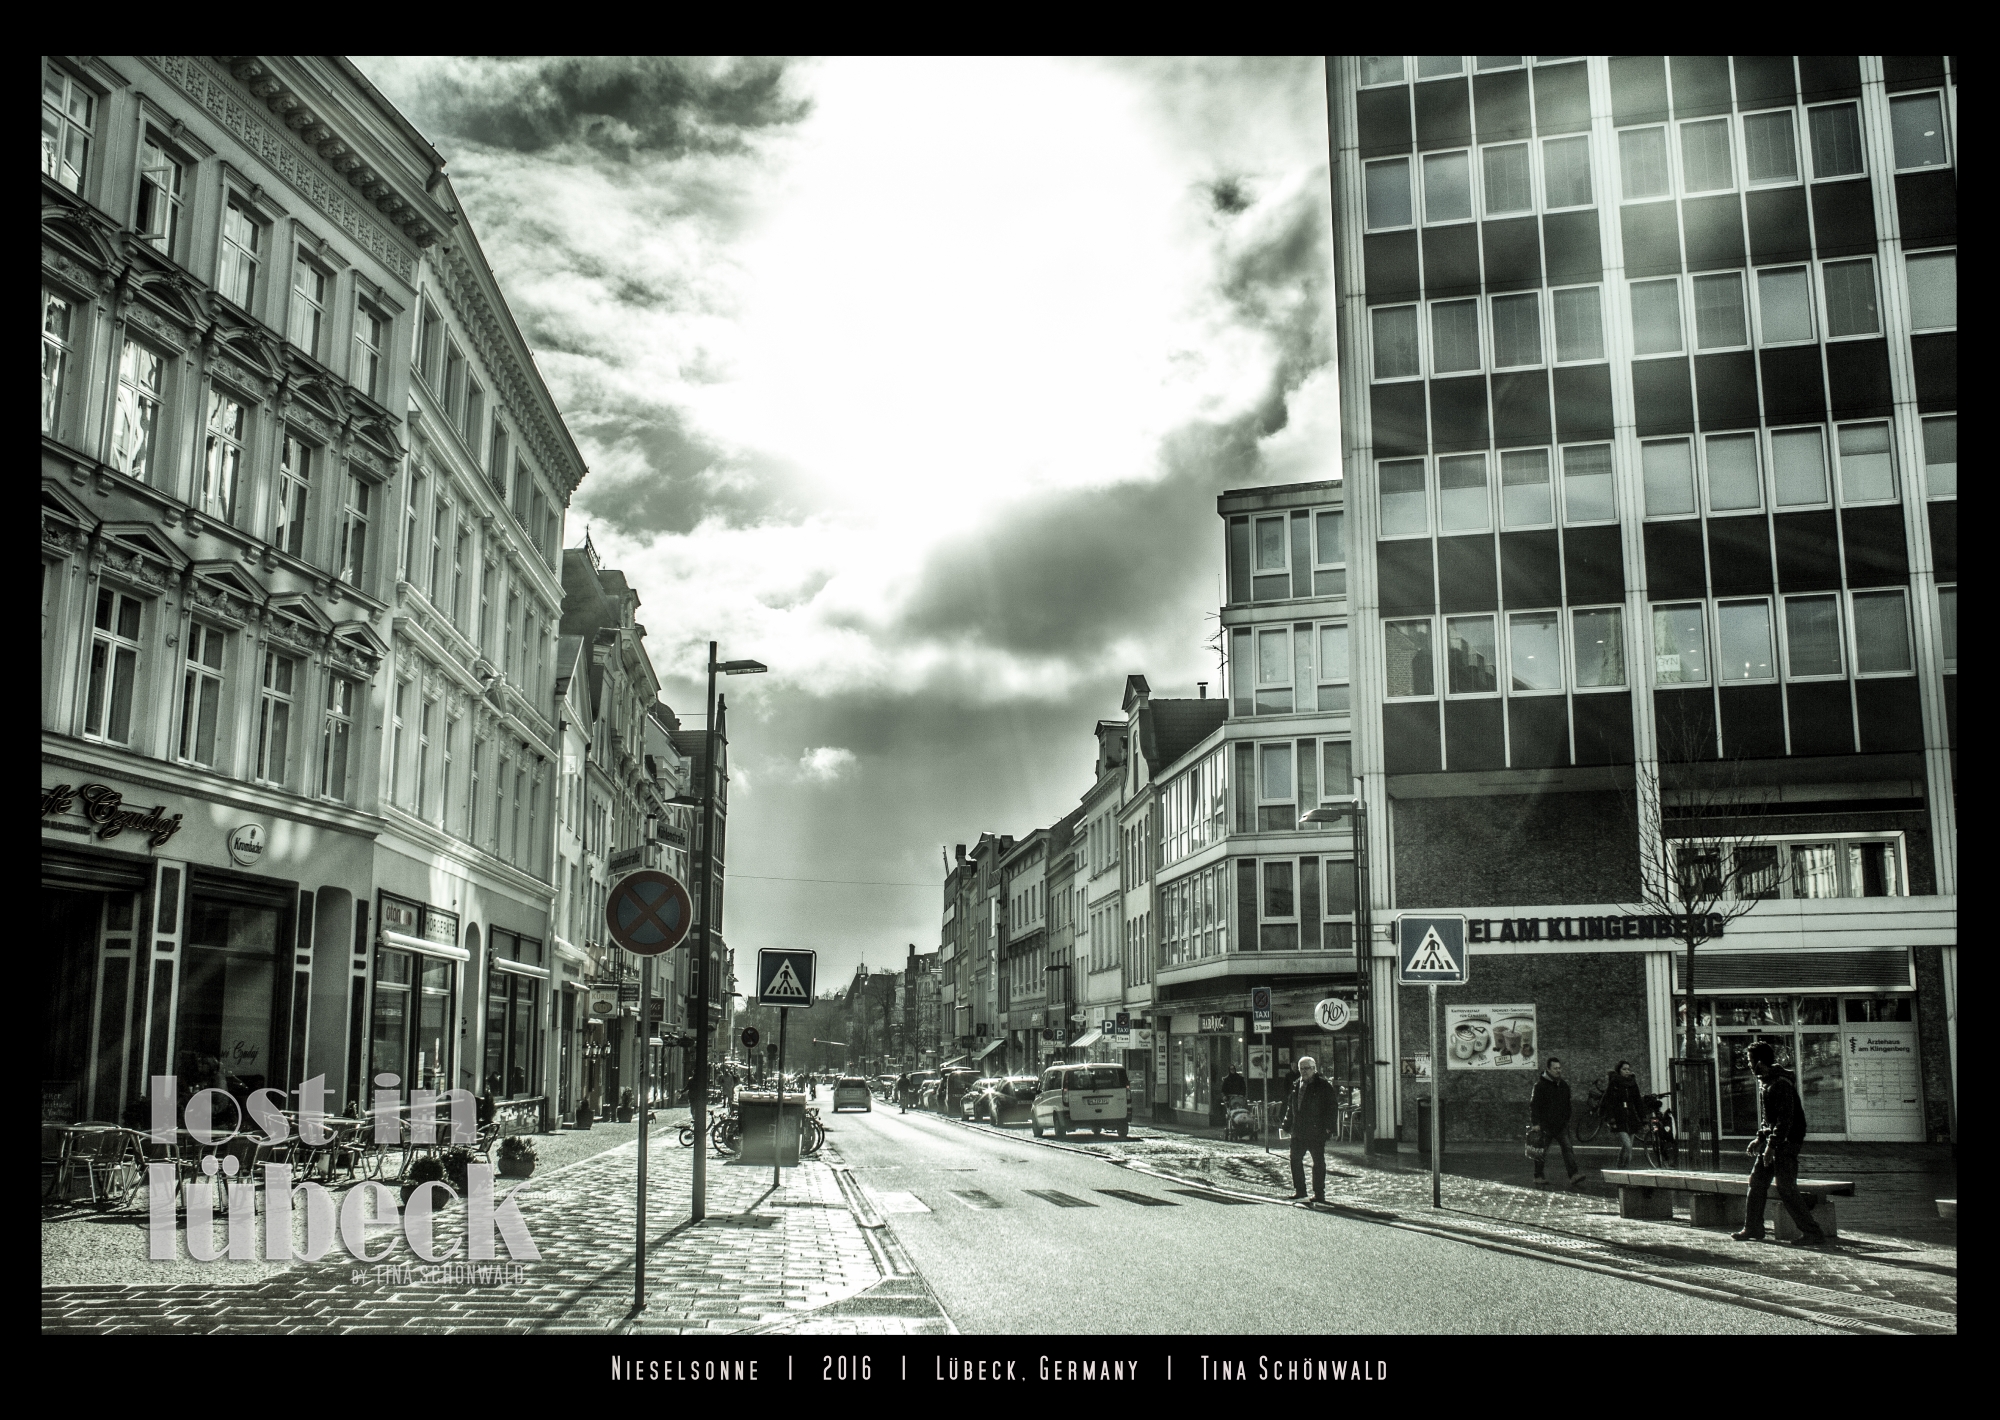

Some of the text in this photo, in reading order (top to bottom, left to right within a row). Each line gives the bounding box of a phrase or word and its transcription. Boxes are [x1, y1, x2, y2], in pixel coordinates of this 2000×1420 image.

[80, 783, 183, 848] Czudaj
[657, 824, 686, 846] Mühlenstraße
[233, 837, 264, 855] Krombacher
[1499, 917, 1540, 943] AM
[1547, 913, 1724, 942] KLINGENBERG
[591, 990, 616, 1000] KÜRBIS
[1255, 1011, 1270, 1019] TAXI
[1104, 1021, 1113, 1033] P
[1056, 1030, 1064, 1039] P
[1866, 1037, 1900, 1045] Ärztehaus
[1870, 1045, 1910, 1053] Klingenberg
